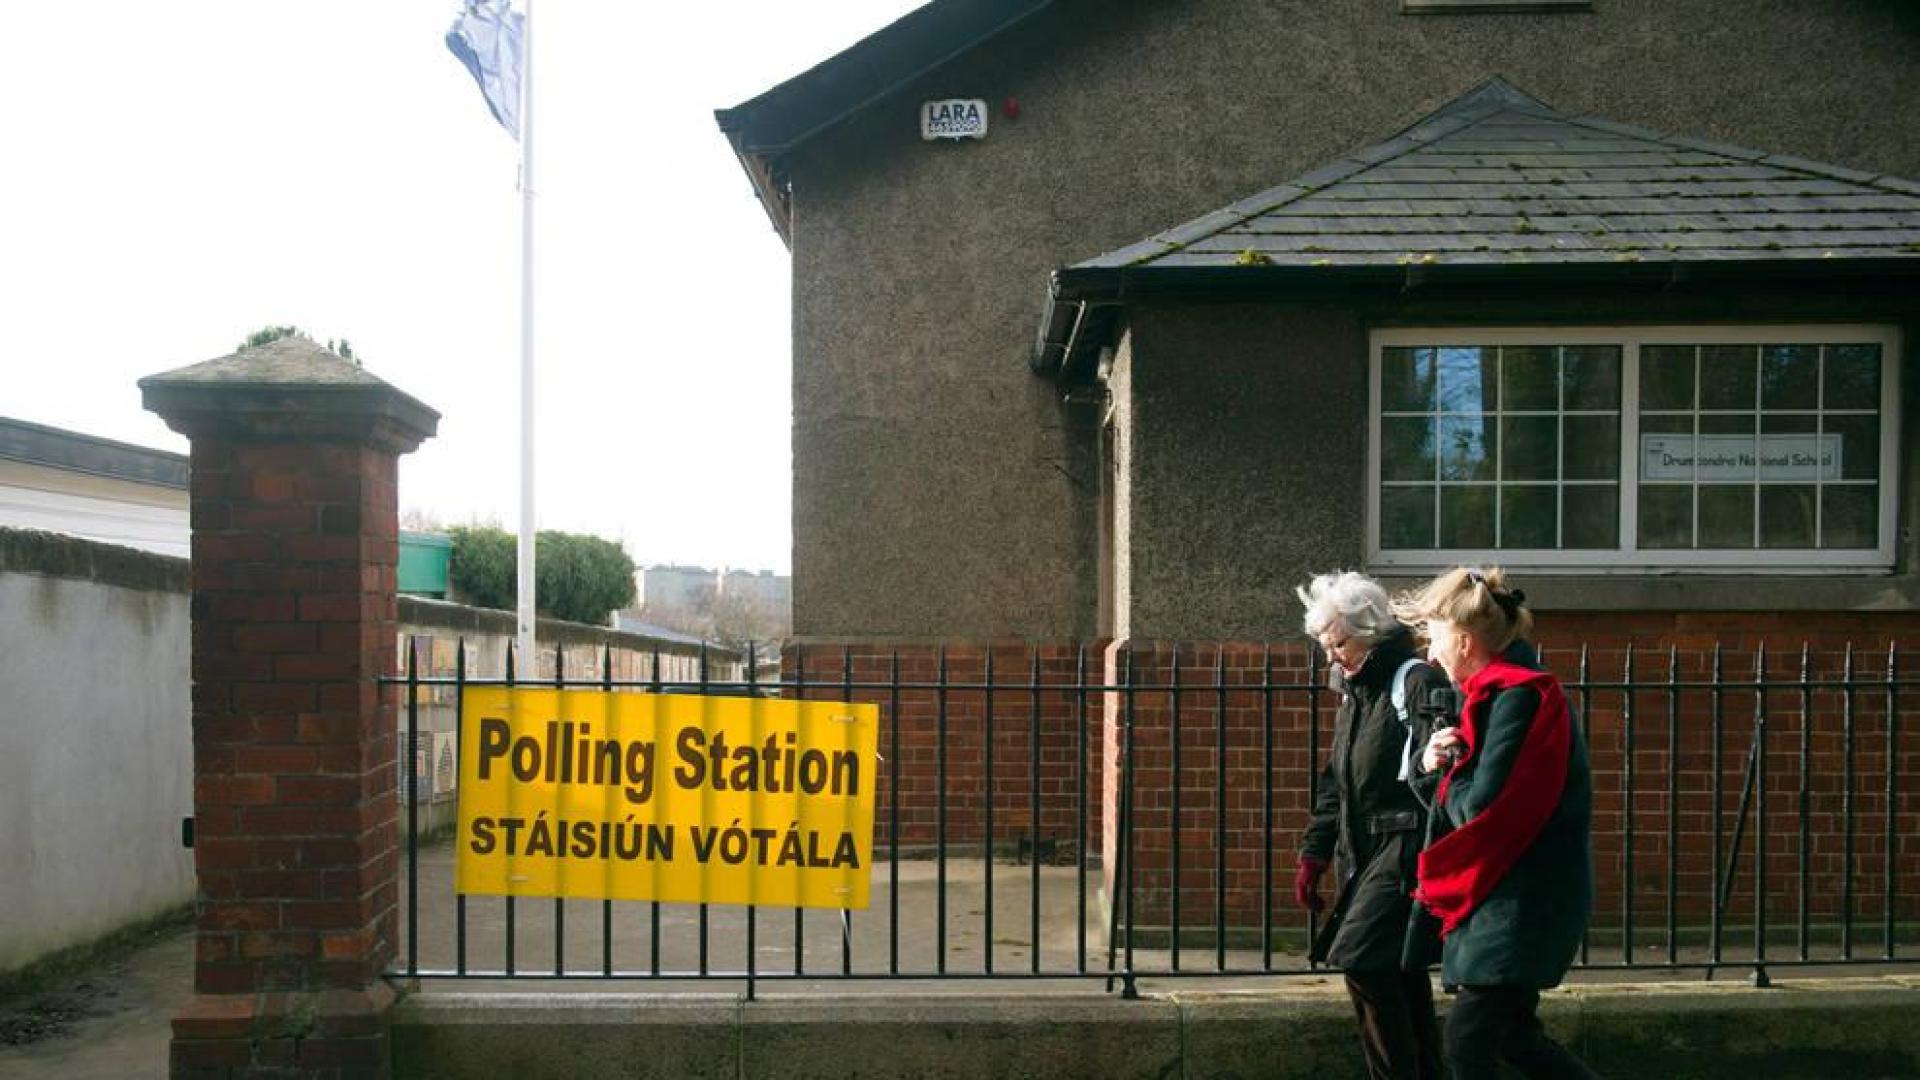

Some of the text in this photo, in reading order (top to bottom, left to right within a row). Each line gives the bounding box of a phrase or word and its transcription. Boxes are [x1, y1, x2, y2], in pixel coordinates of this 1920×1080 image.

[928, 103, 980, 121] LARA
[1739, 453, 1788, 466] Naional
[1792, 453, 1831, 466] Schol
[478, 718, 859, 804] Polling Station
[470, 810, 860, 869] STÁISIÚN VÓTÁLA
